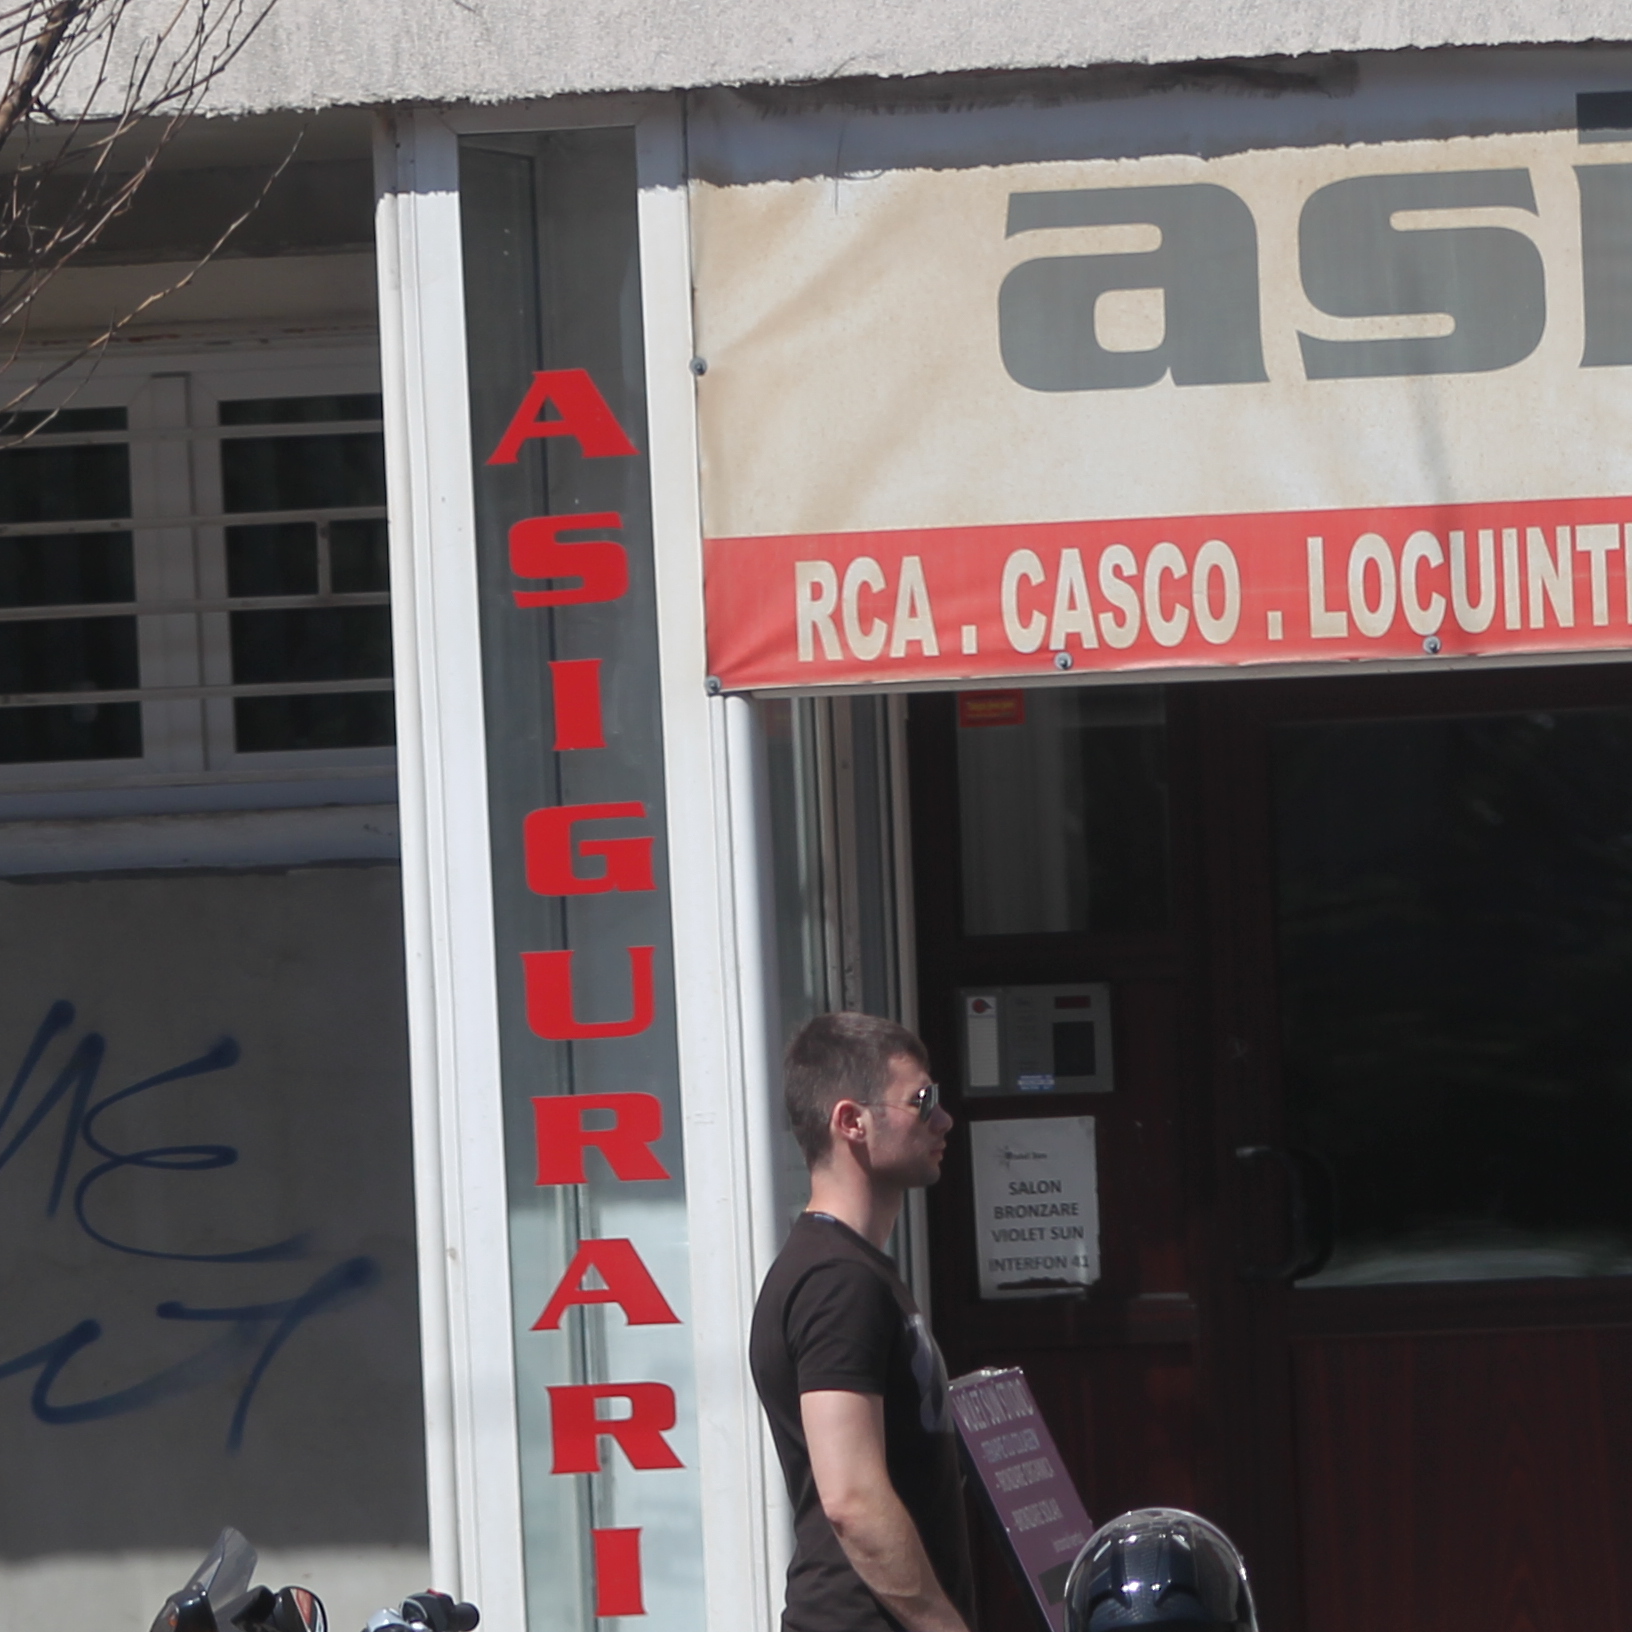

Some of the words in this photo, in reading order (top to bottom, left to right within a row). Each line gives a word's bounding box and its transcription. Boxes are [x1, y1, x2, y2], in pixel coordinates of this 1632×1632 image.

[795, 554, 940, 663] RCA
[1001, 539, 1241, 654] CASCO
[486, 367, 686, 1618] ASIGURARI
[1009, 1180, 1062, 1196] SALON
[993, 1202, 1080, 1220] BRONZARE
[991, 1226, 1045, 1242] VIOLET
[1050, 1225, 1085, 1240] SUN
[988, 1254, 1068, 1272] INTERFON
